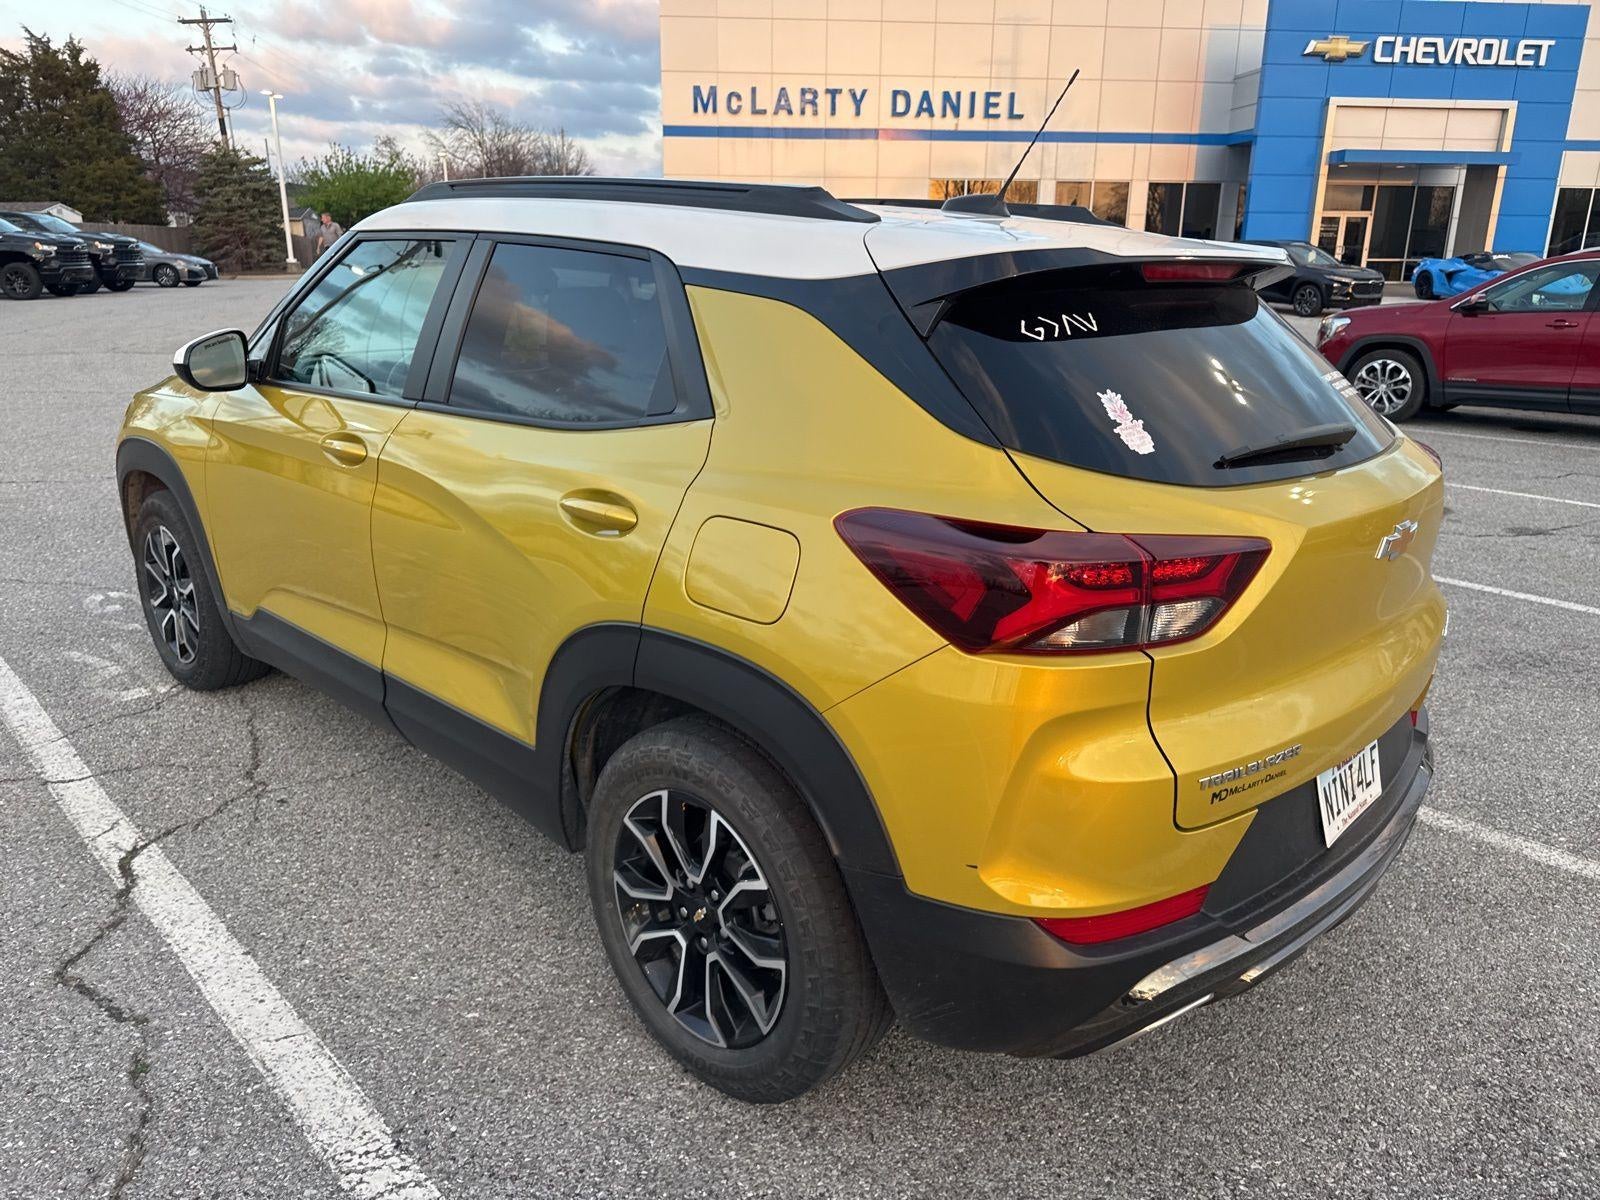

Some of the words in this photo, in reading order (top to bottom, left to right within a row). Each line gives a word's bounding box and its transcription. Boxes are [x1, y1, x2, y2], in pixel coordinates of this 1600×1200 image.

[1373, 35, 1556, 67] CHEVROLET
[692, 84, 868, 118] McLARTY
[890, 90, 1025, 120] DANIEL
[1198, 743, 1303, 791] TRAILBLAZER
[1322, 744, 1377, 826] NINI4LF
